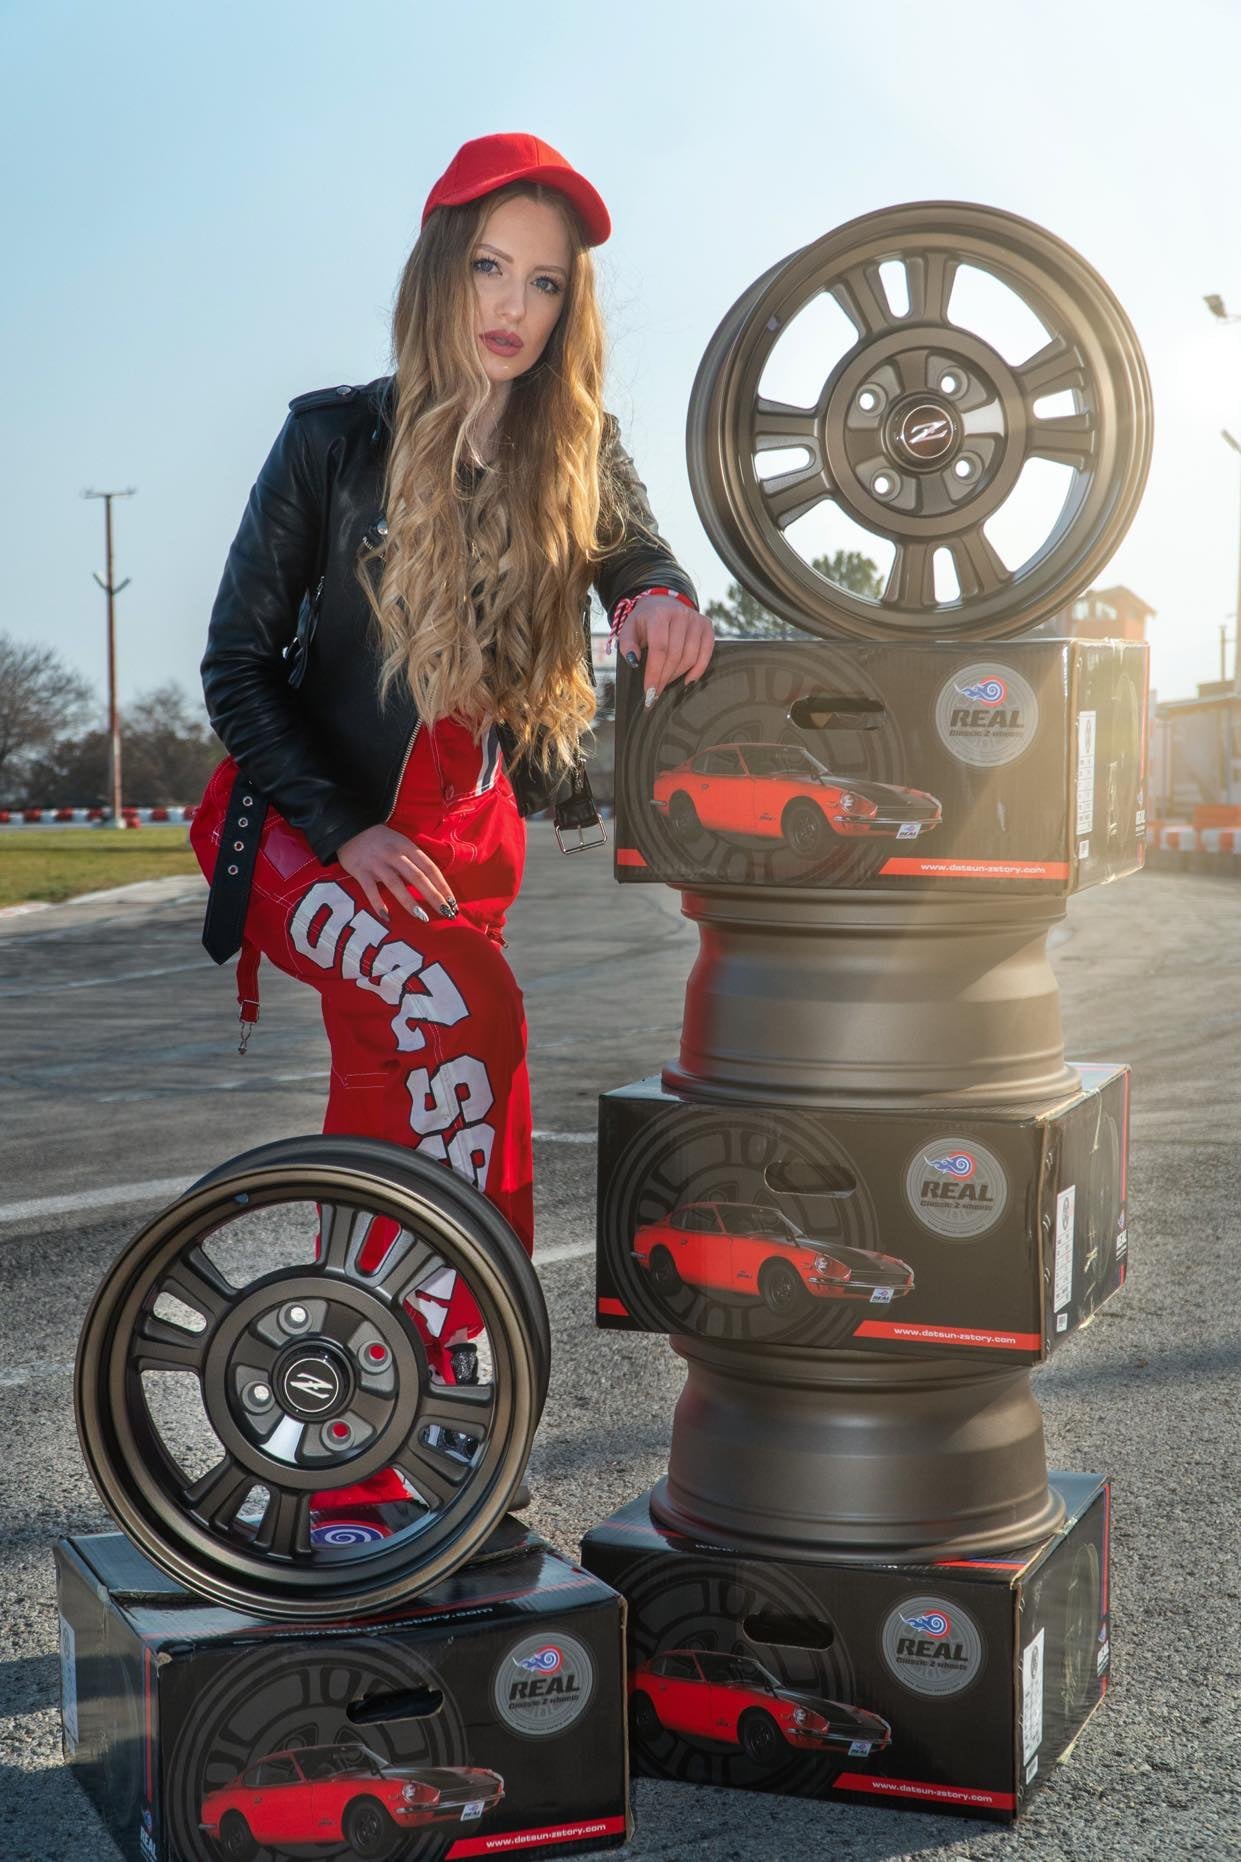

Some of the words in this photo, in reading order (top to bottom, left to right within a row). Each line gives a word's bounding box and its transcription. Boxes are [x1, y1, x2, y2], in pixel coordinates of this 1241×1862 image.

[950, 709, 1025, 729] REAL
[920, 863, 1046, 874] www.datsun-zstory.com
[920, 1180, 994, 1203] REAL
[893, 1327, 1016, 1344] www.datsun-zstory.com
[896, 1638, 968, 1662] REAL
[508, 1674, 580, 1701] REAL
[872, 1781, 993, 1803] www.datsun-zstory.com
[486, 1823, 607, 1848] www.datsun-zstory.com
